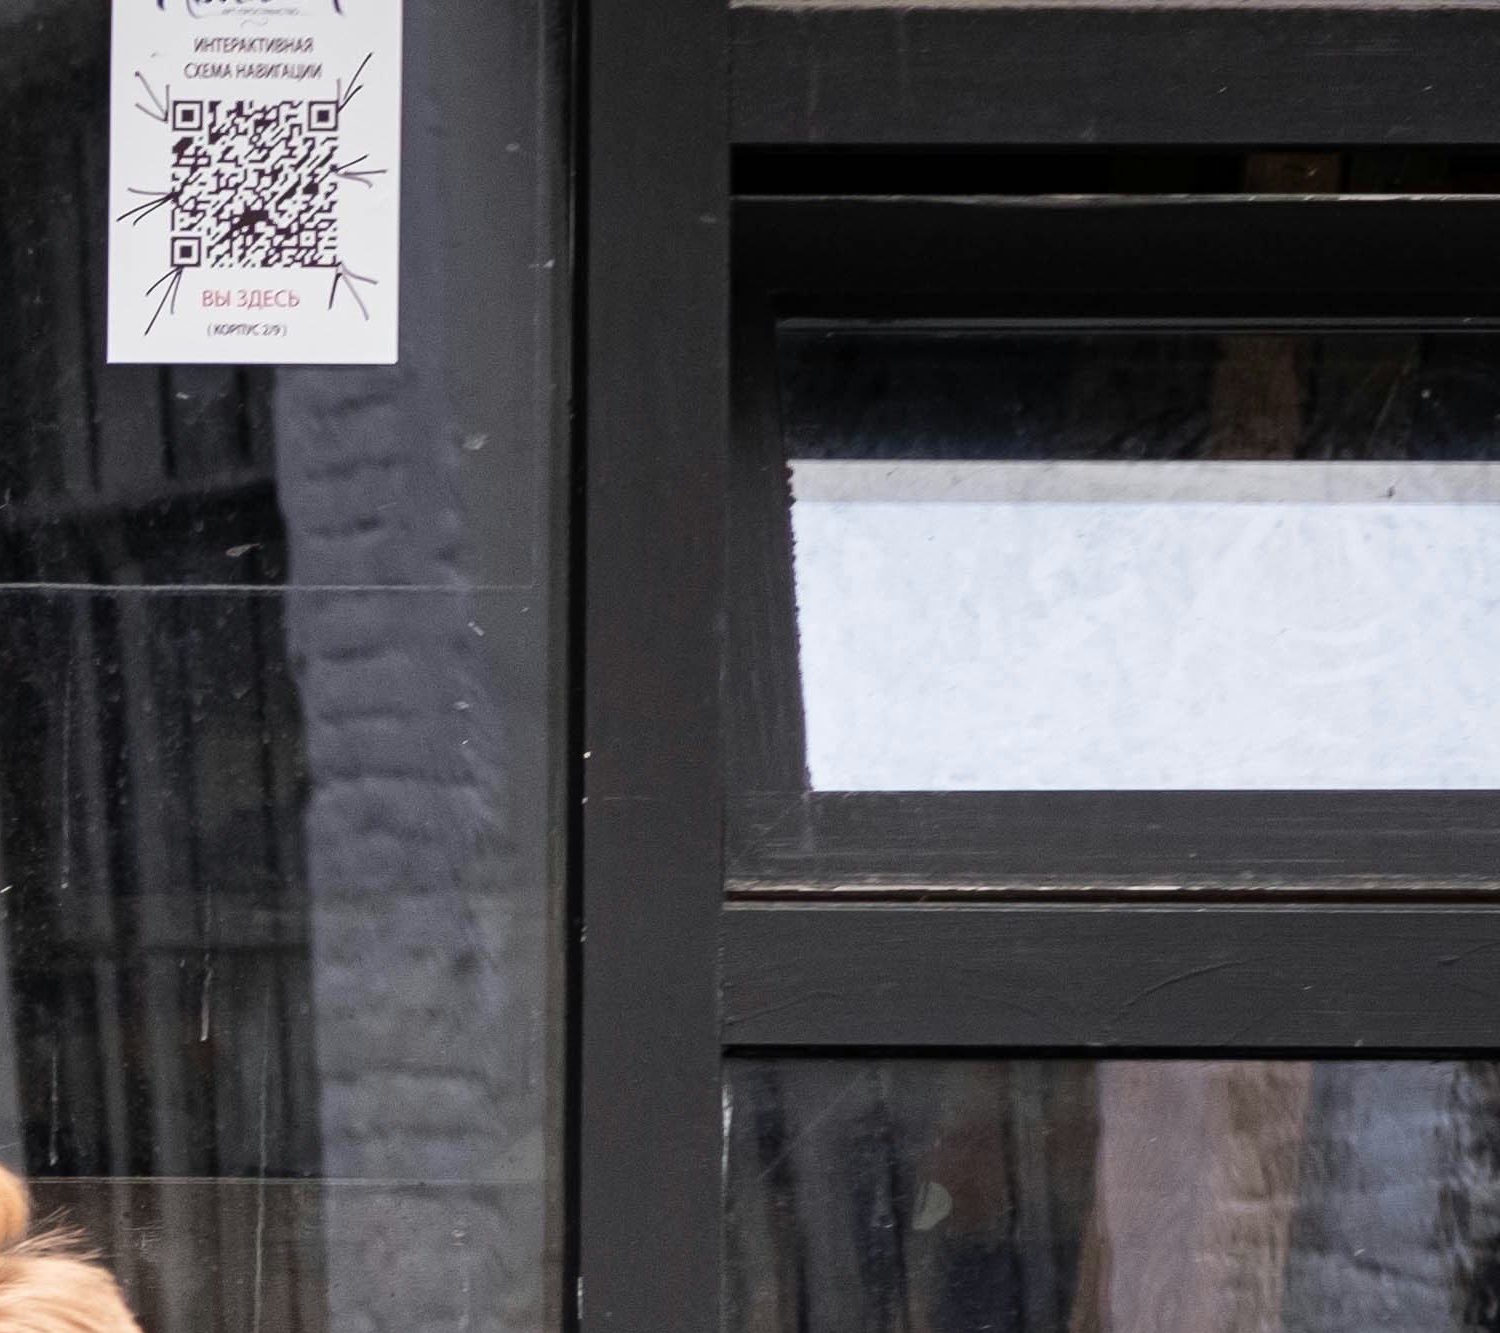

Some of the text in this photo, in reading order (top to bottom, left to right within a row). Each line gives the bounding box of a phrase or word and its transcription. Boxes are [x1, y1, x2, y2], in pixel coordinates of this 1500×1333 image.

[193, 37, 314, 53] ИНТЕРАКТИВНАЯ
[183, 62, 323, 81] СХЕМА НАВИГАЦИИ
[202, 289, 300, 310] ВЫ ЗДЕСЬ
